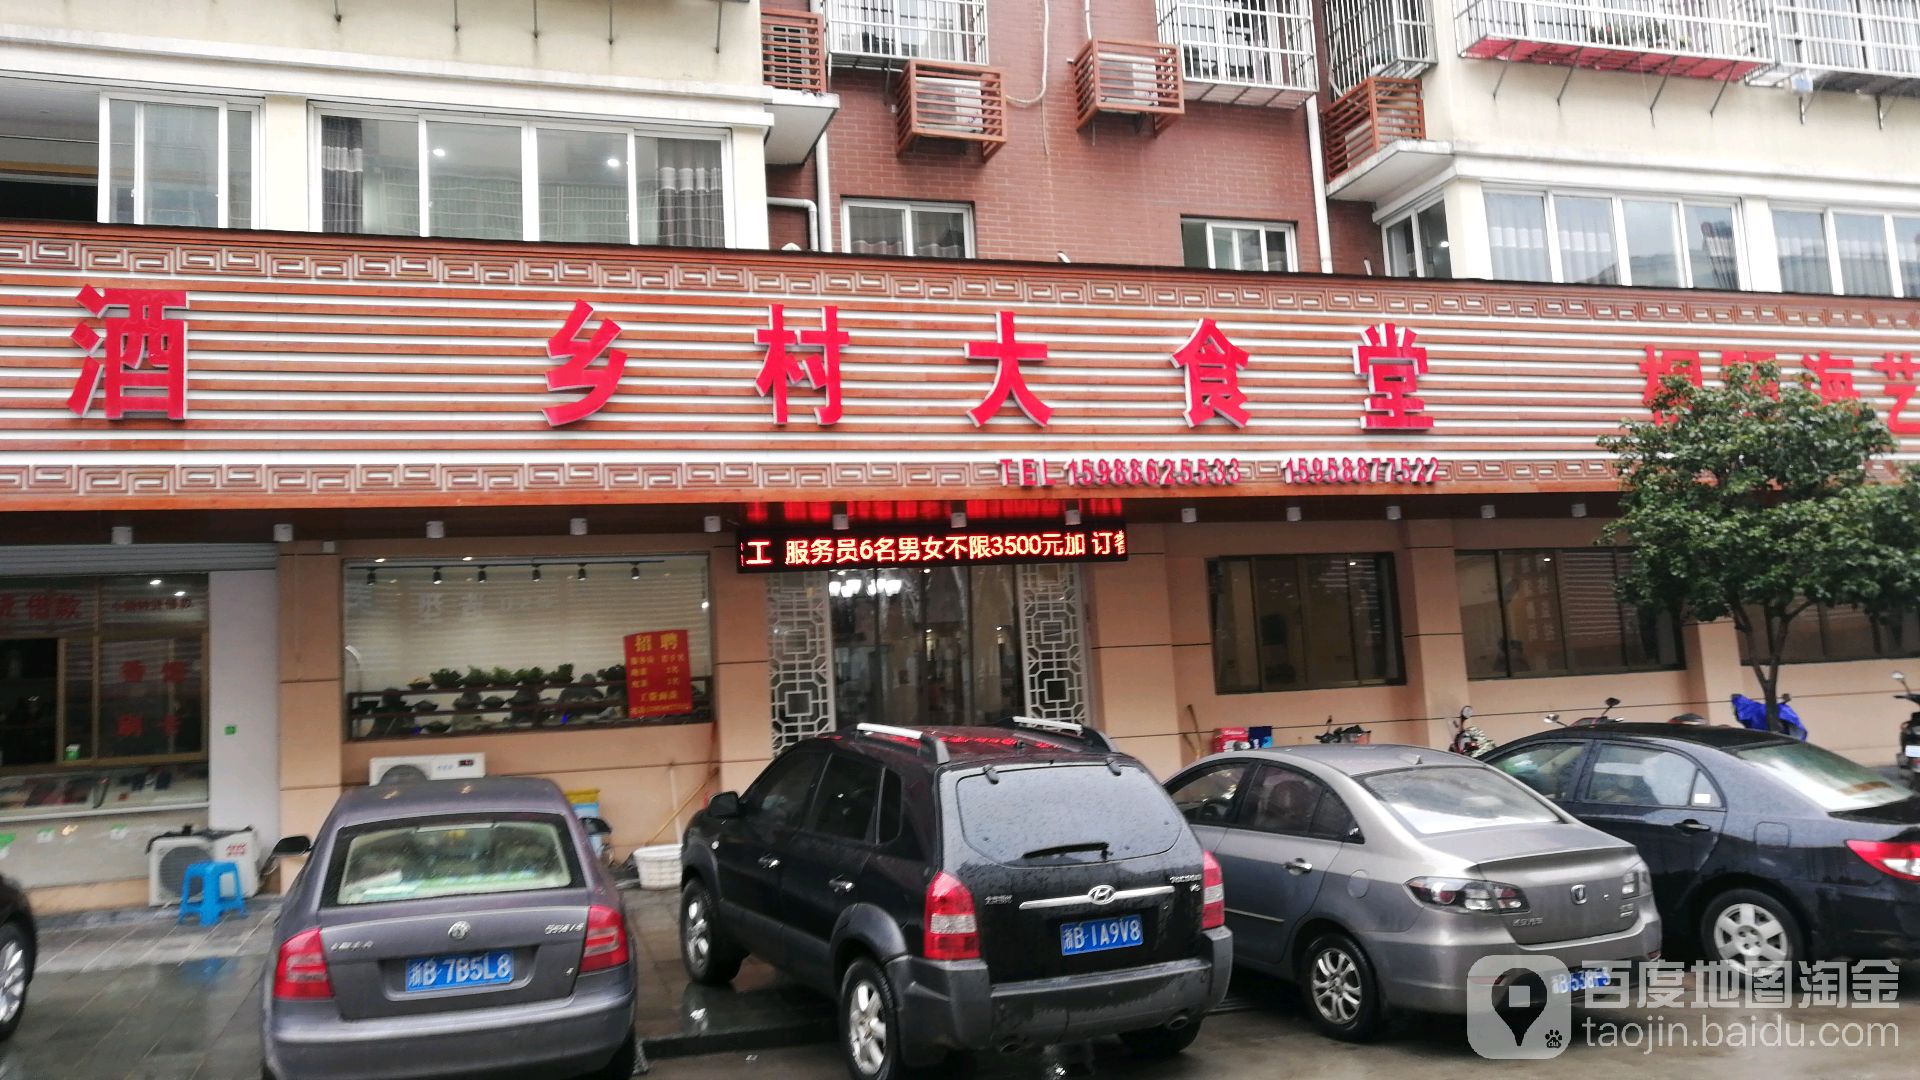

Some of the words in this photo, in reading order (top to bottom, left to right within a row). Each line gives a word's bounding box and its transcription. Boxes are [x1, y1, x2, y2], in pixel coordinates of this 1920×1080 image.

[67, 284, 189, 421] 酒
[542, 298, 1434, 434] 乡村大食堂
[1000, 458, 1053, 487] TEL
[1066, 458, 1242, 489] 15988625533
[1281, 457, 1438, 487] 15958877522
[740, 540, 772, 566] 工
